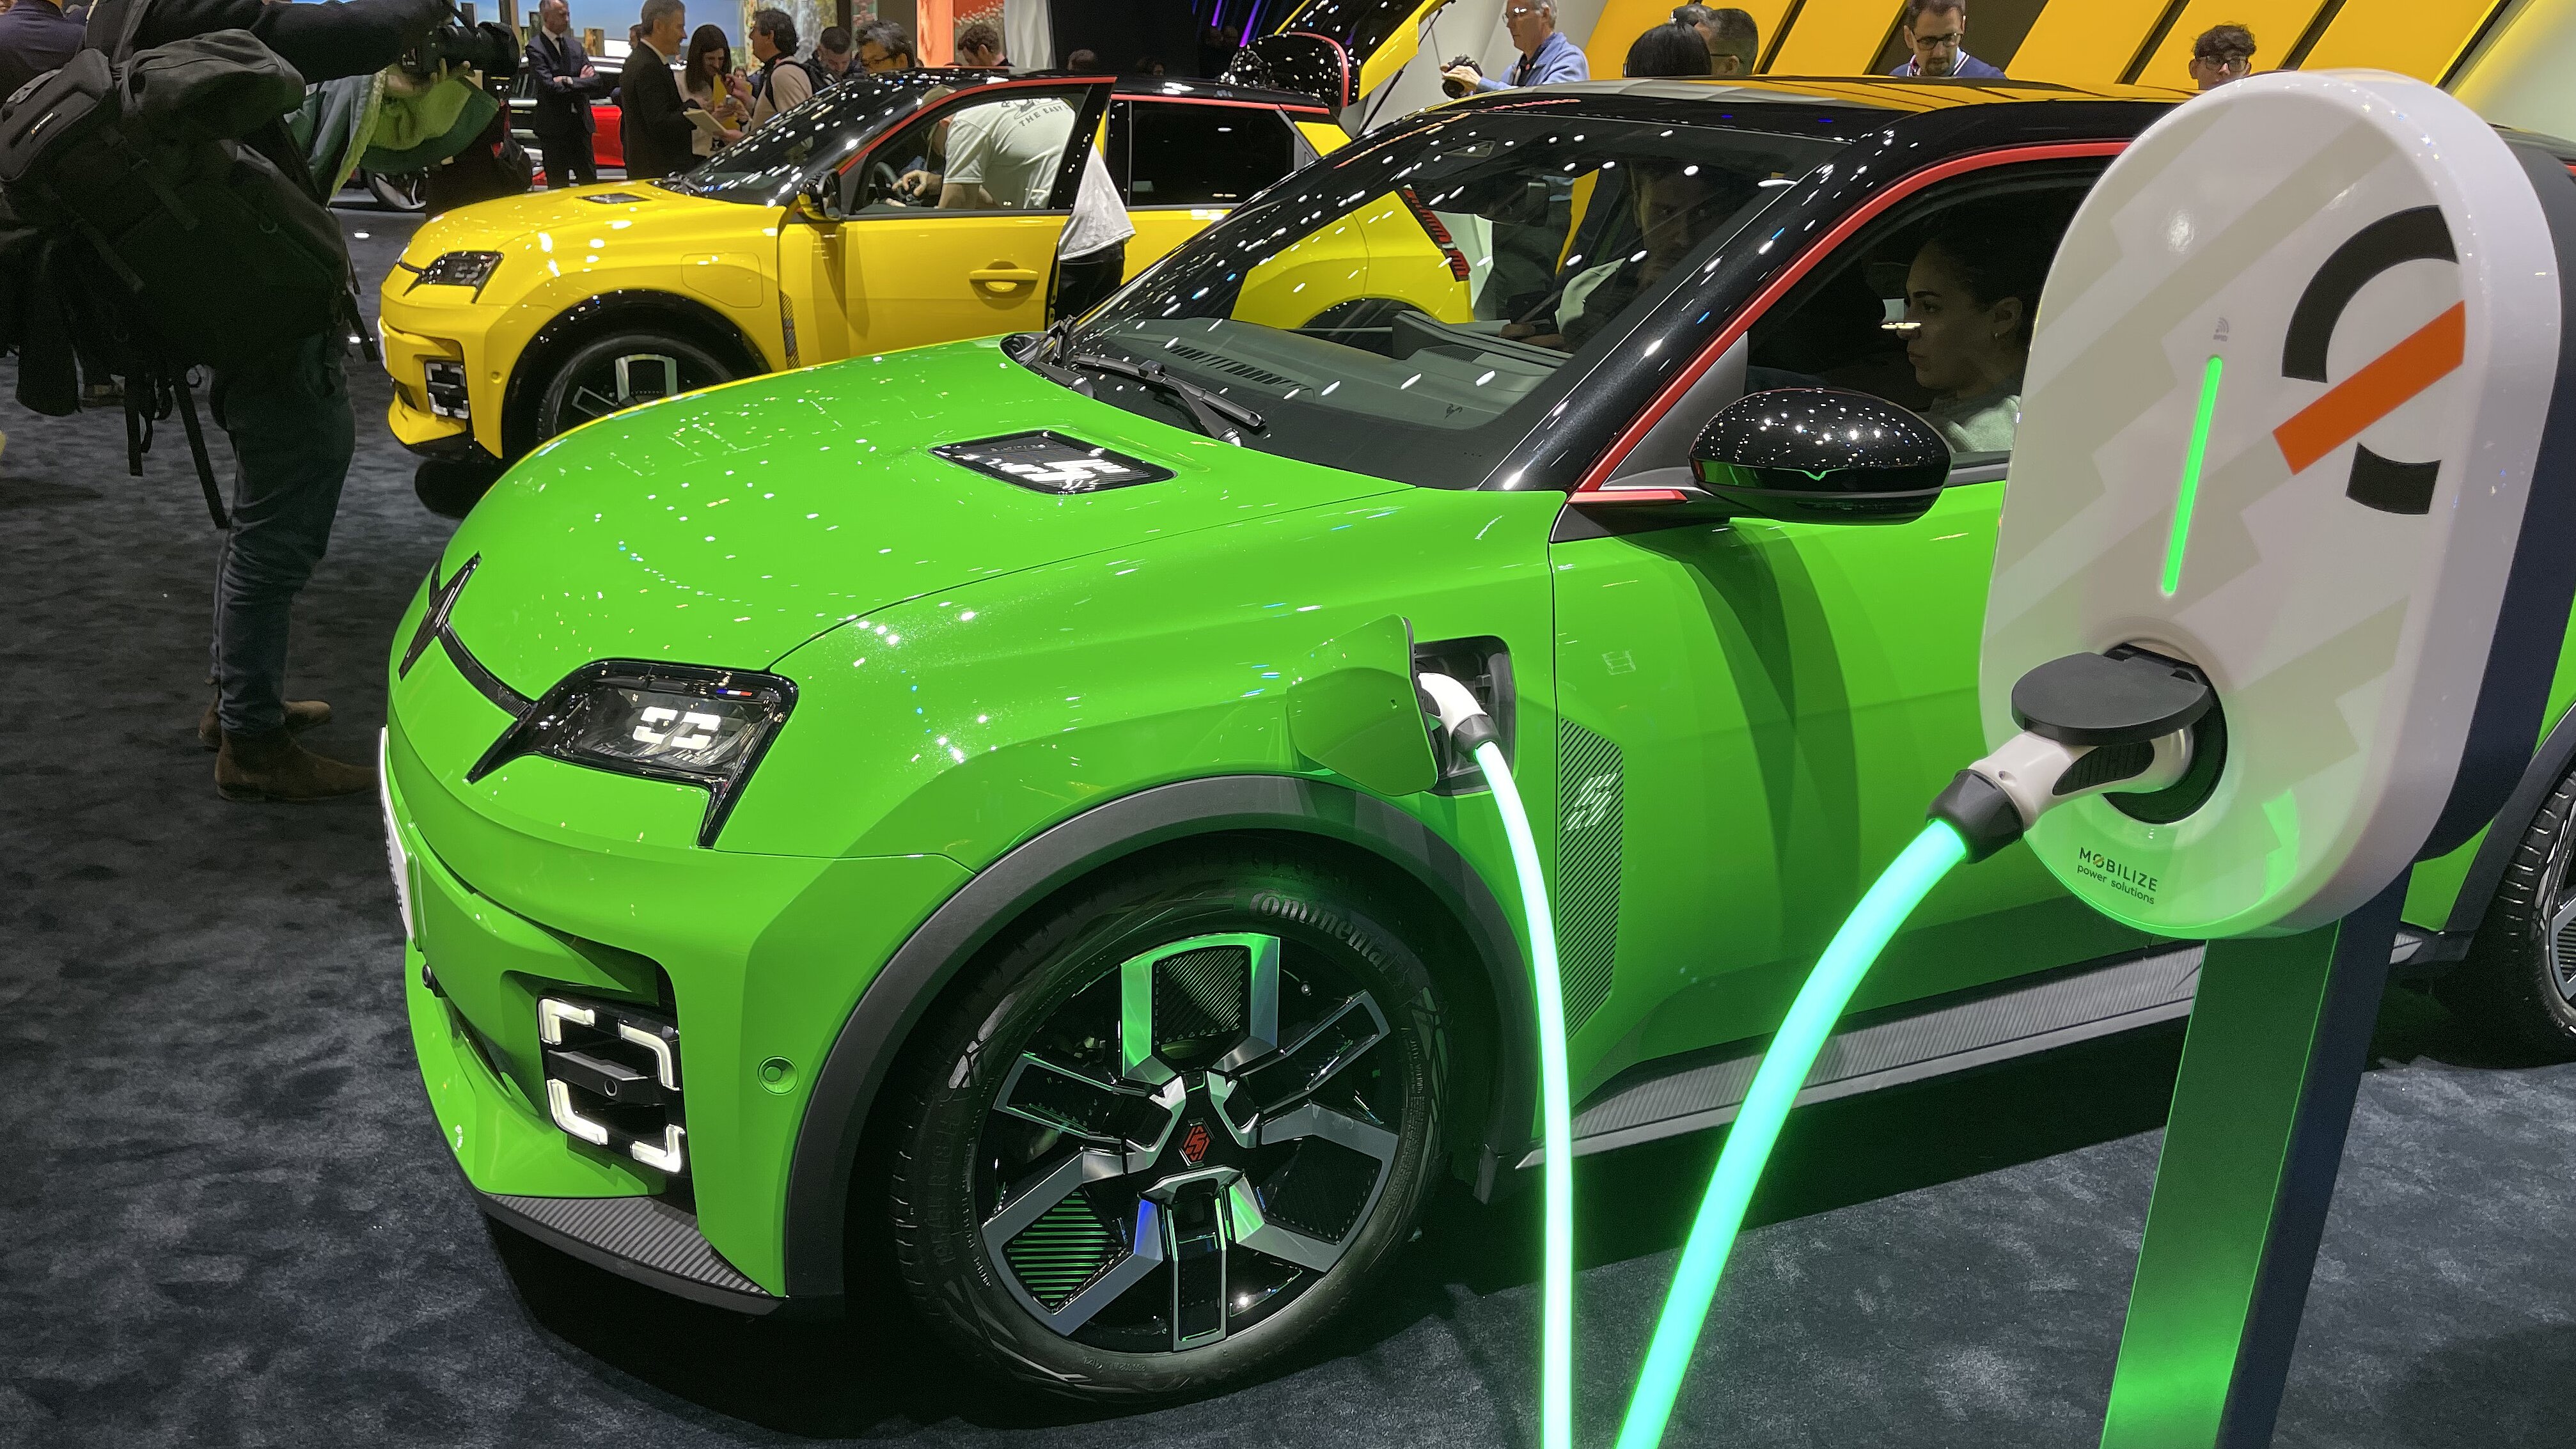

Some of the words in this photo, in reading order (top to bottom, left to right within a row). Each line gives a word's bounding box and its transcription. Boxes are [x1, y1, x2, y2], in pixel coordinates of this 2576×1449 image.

[1019, 111, 1041, 127] THE
[2077, 865, 2107, 883] power
[2110, 879, 2155, 905] solutions
[2078, 847, 2158, 892] MOBILIZE
[1248, 889, 1399, 975] Continental
